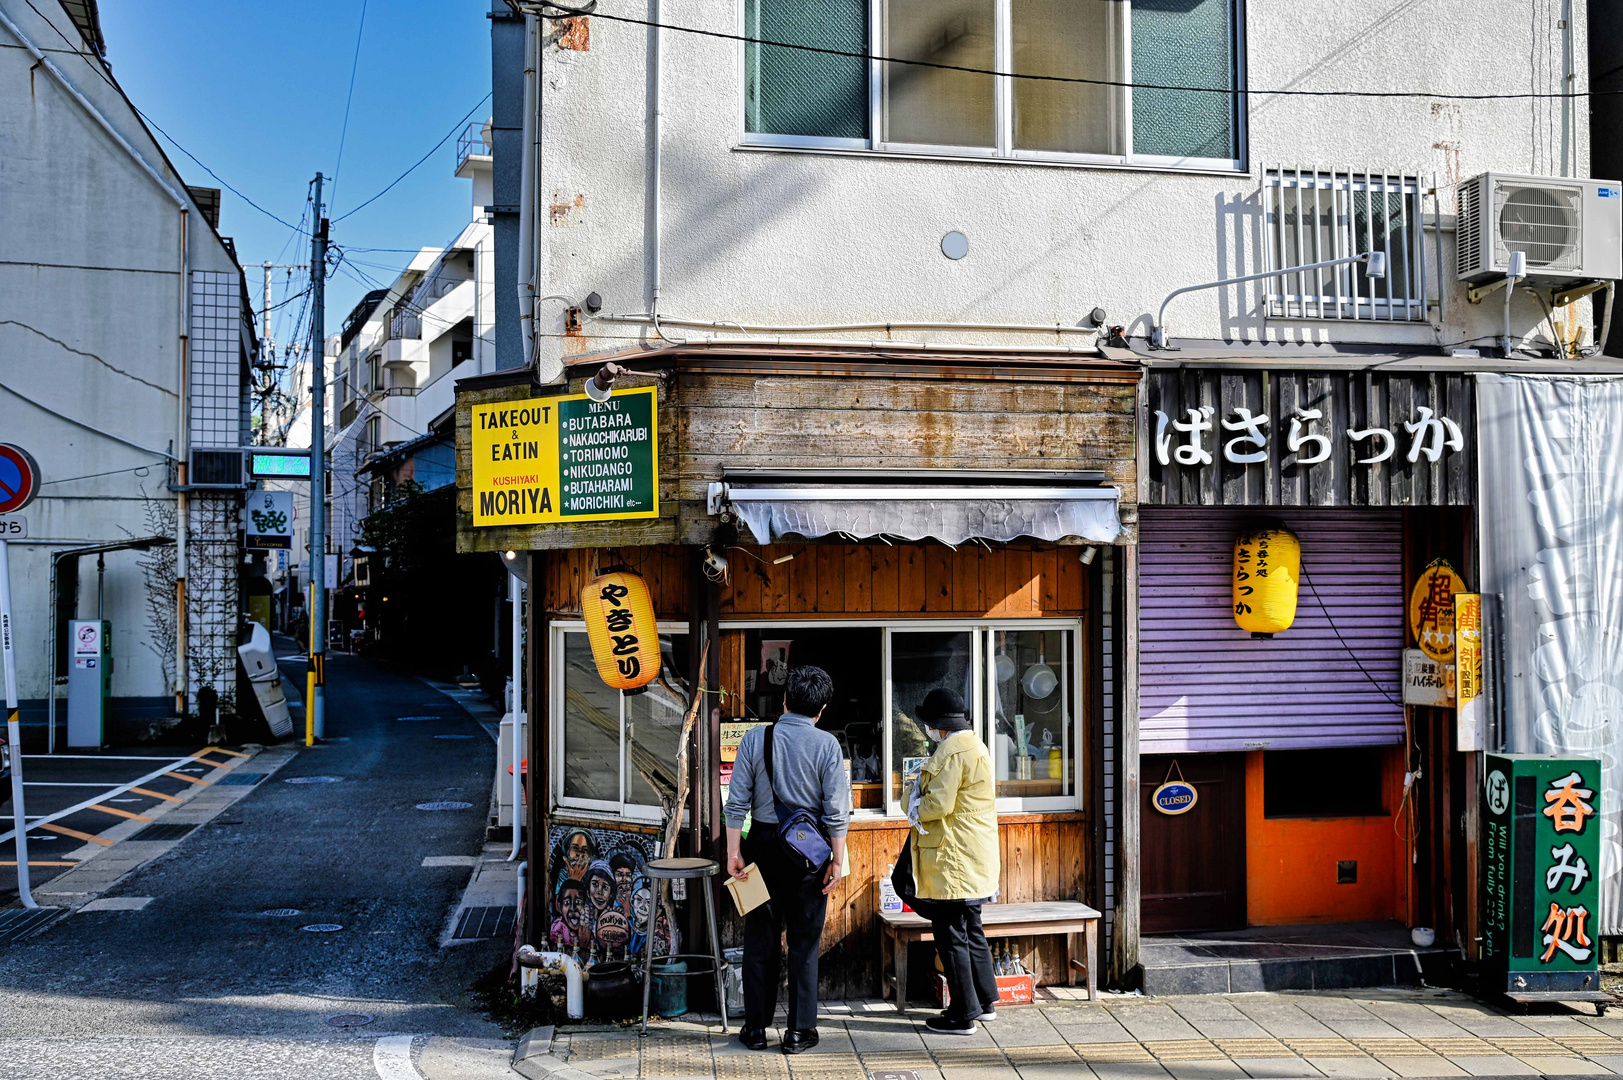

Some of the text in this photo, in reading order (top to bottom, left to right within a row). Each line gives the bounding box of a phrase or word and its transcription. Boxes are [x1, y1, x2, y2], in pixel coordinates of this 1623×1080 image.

[588, 401, 621, 413] MENU
[479, 406, 551, 430] TAKEOUT
[569, 413, 632, 431] BUTABARA
[511, 430, 519, 440] &
[569, 428, 648, 447] NAKAOCHIKARUBI
[492, 441, 539, 462] EATIN
[569, 446, 629, 463] TORIMOMO
[570, 462, 633, 478] NIKUDANGO
[493, 474, 539, 486] KUSHIYAKI
[570, 478, 633, 495] BUTAHARAMI
[480, 487, 552, 517] MORIYA
[570, 495, 624, 510] MORICHIKI
[599, 583, 641, 680] やきとり
[1159, 795, 1192, 806] CLOSED
[1488, 821, 1497, 859] From
[1541, 770, 1596, 964] 呑み処
[1486, 864, 1496, 895] fully
[1496, 825, 1507, 931] Will you drink?
